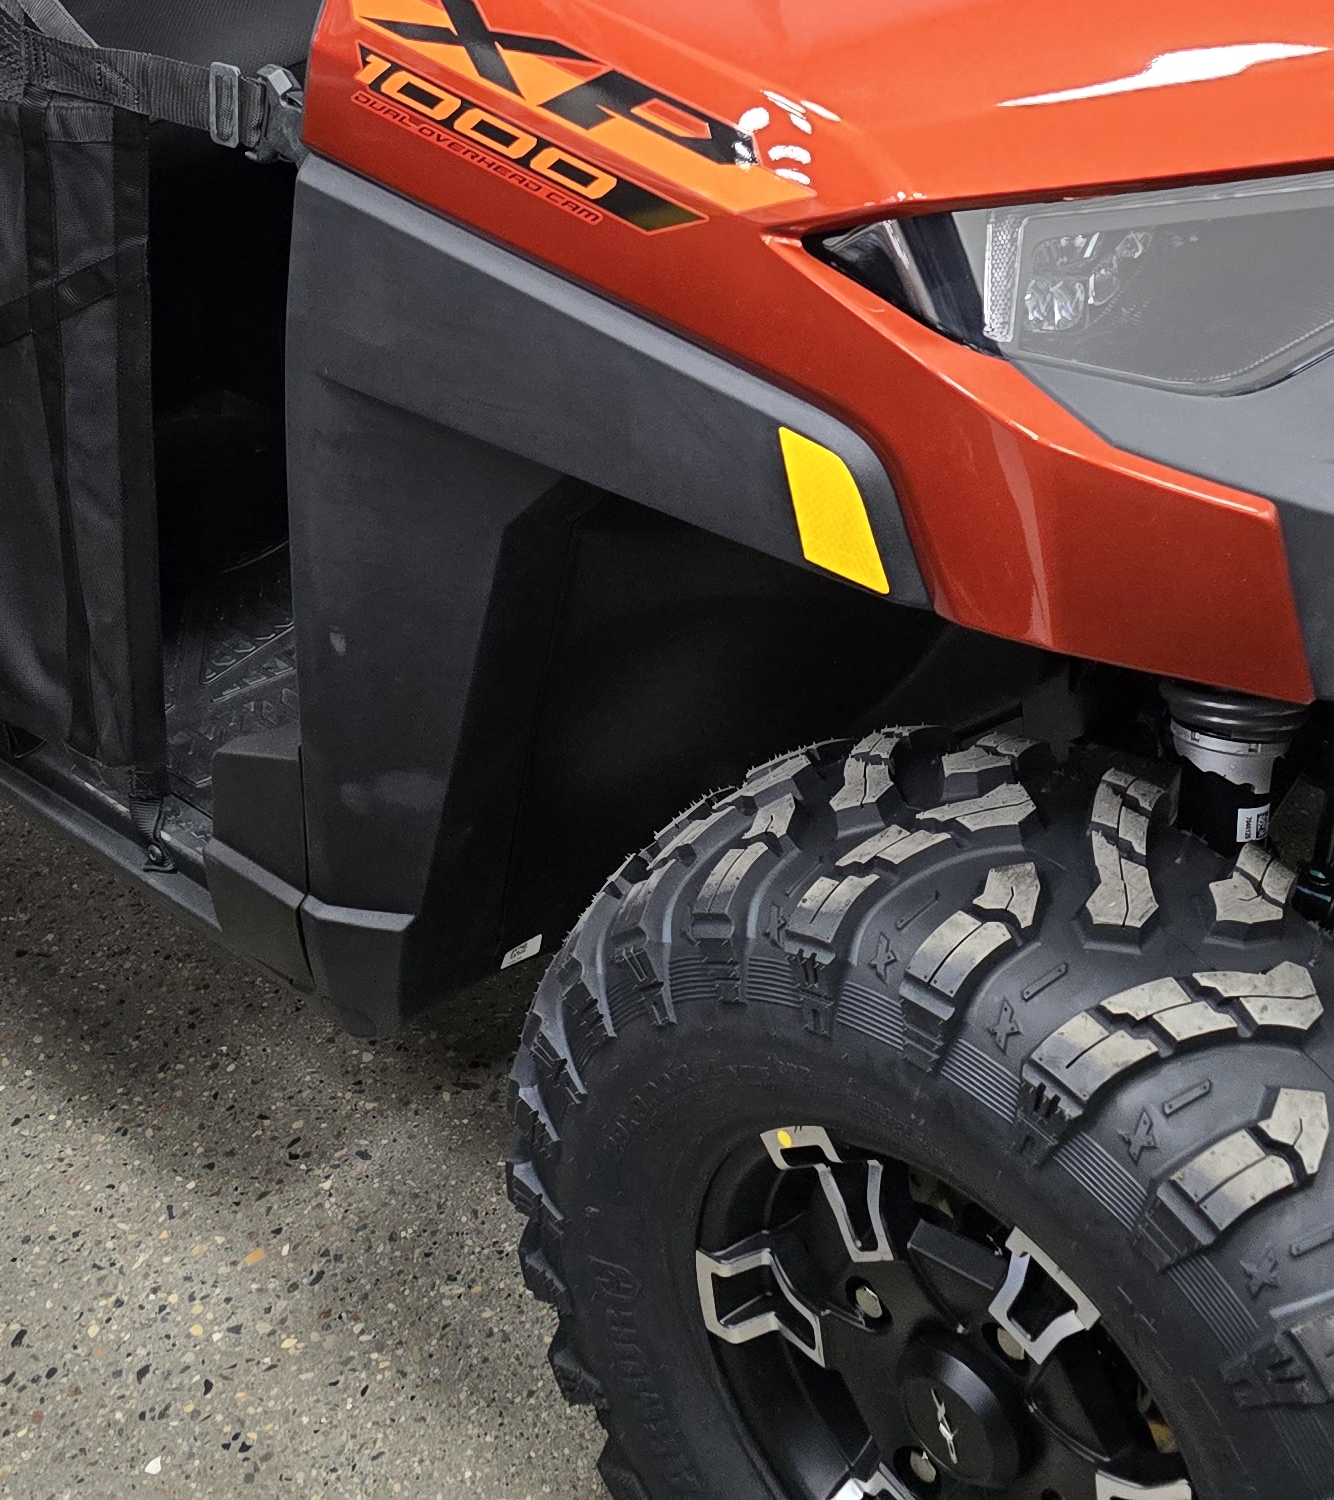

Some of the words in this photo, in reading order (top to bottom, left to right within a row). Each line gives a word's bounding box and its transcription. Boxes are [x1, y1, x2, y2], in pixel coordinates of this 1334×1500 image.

[354, 93, 413, 128] DUAL
[418, 125, 543, 193] OVERHEAD
[546, 192, 600, 224] CAM
[355, 54, 618, 200] 1000
